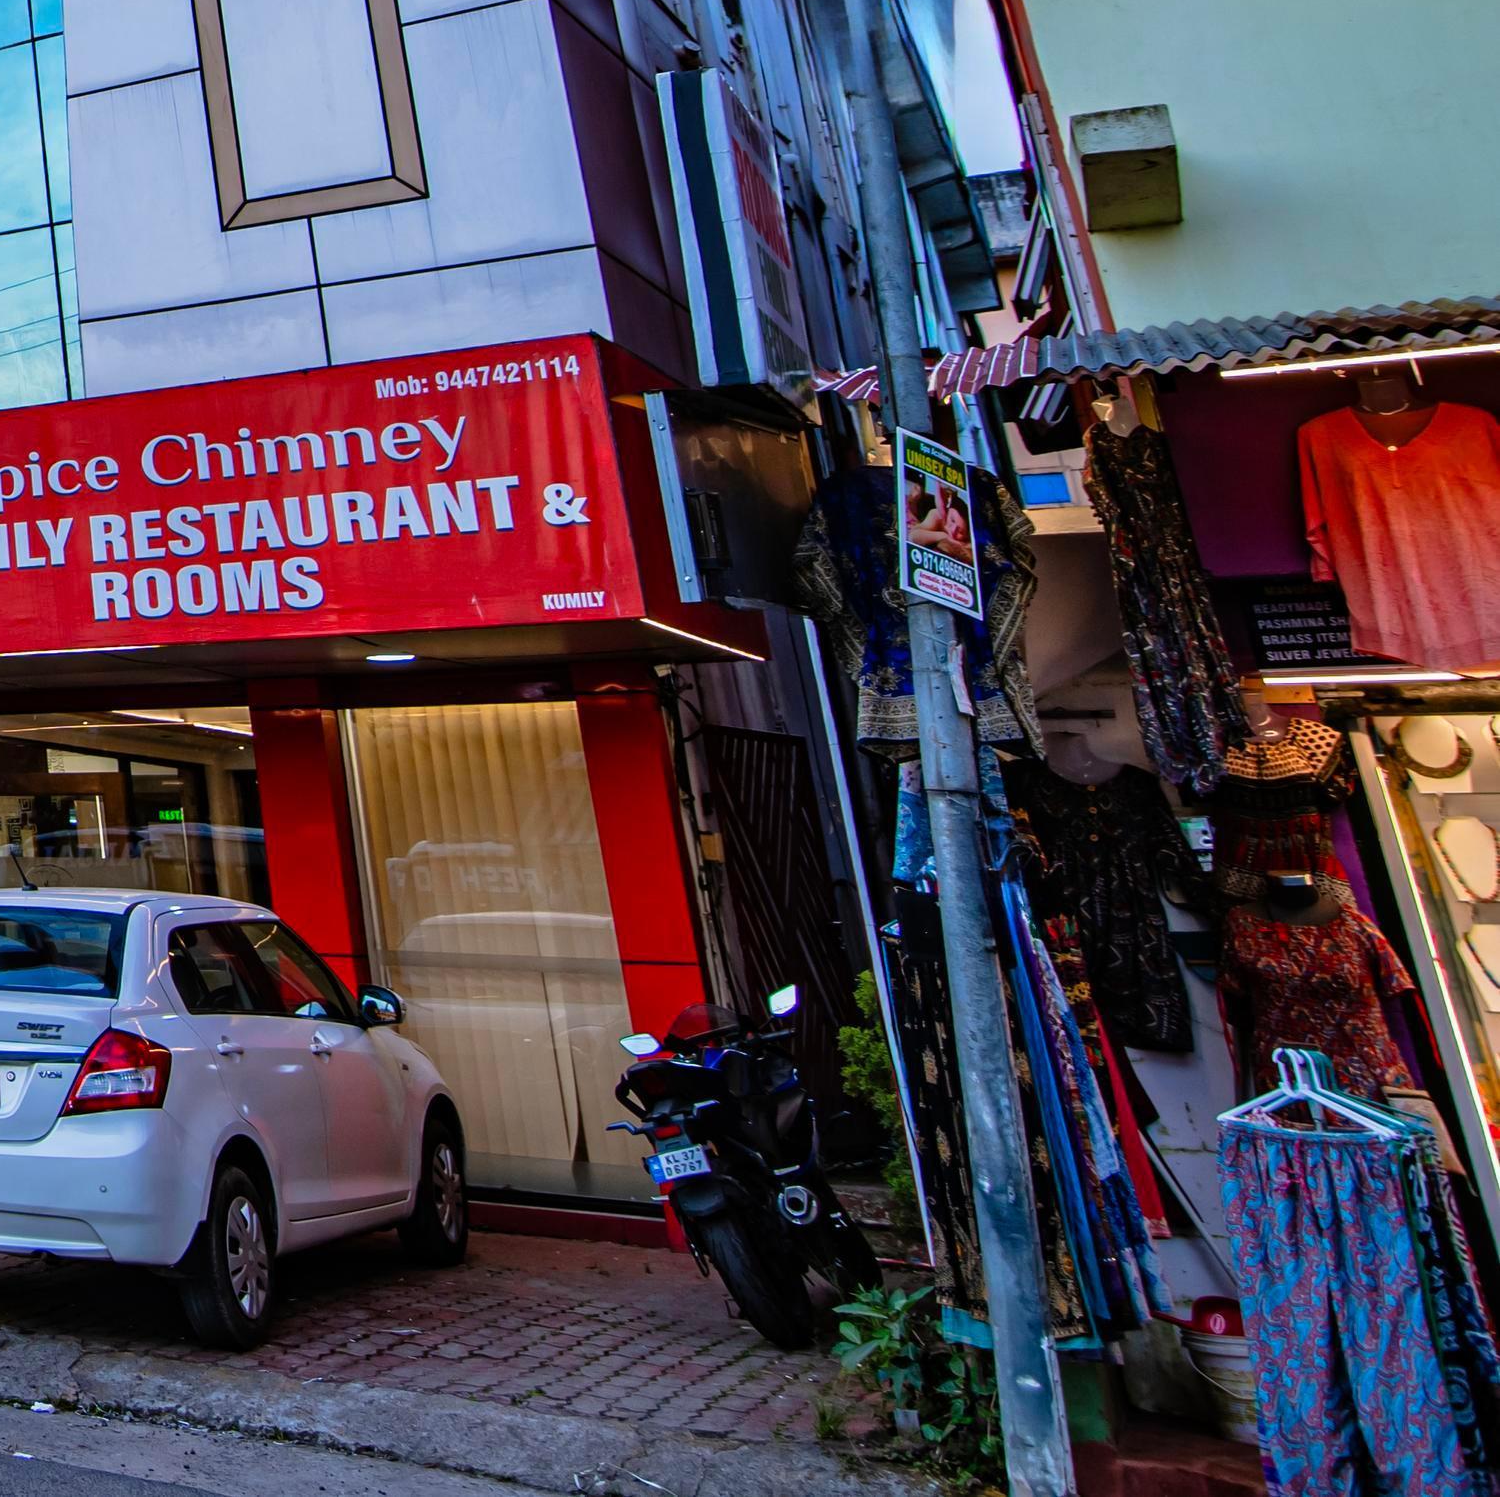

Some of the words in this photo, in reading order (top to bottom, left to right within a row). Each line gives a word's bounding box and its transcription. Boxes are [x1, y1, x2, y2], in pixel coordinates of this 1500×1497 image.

[374, 373, 430, 401] Mob:
[435, 355, 581, 391] 9447421114
[141, 415, 467, 488] Chimney
[906, 448, 945, 479] UNISEX
[946, 466, 965, 488] SPA
[89, 475, 520, 566] RESTAURANT
[542, 481, 592, 527] &
[90, 555, 325, 621] ROOMS
[541, 590, 606, 611] KUMILY
[1257, 617, 1326, 629] PASHMINA
[1329, 616, 1350, 626] SH
[1261, 633, 1313, 645] BRAASS
[1317, 632, 1351, 643] ITEM
[1266, 650, 1311, 661] SILVER
[17, 1021, 65, 1032] SWIFT
[664, 1154, 680, 1165] KL
[681, 1149, 695, 1161] 37
